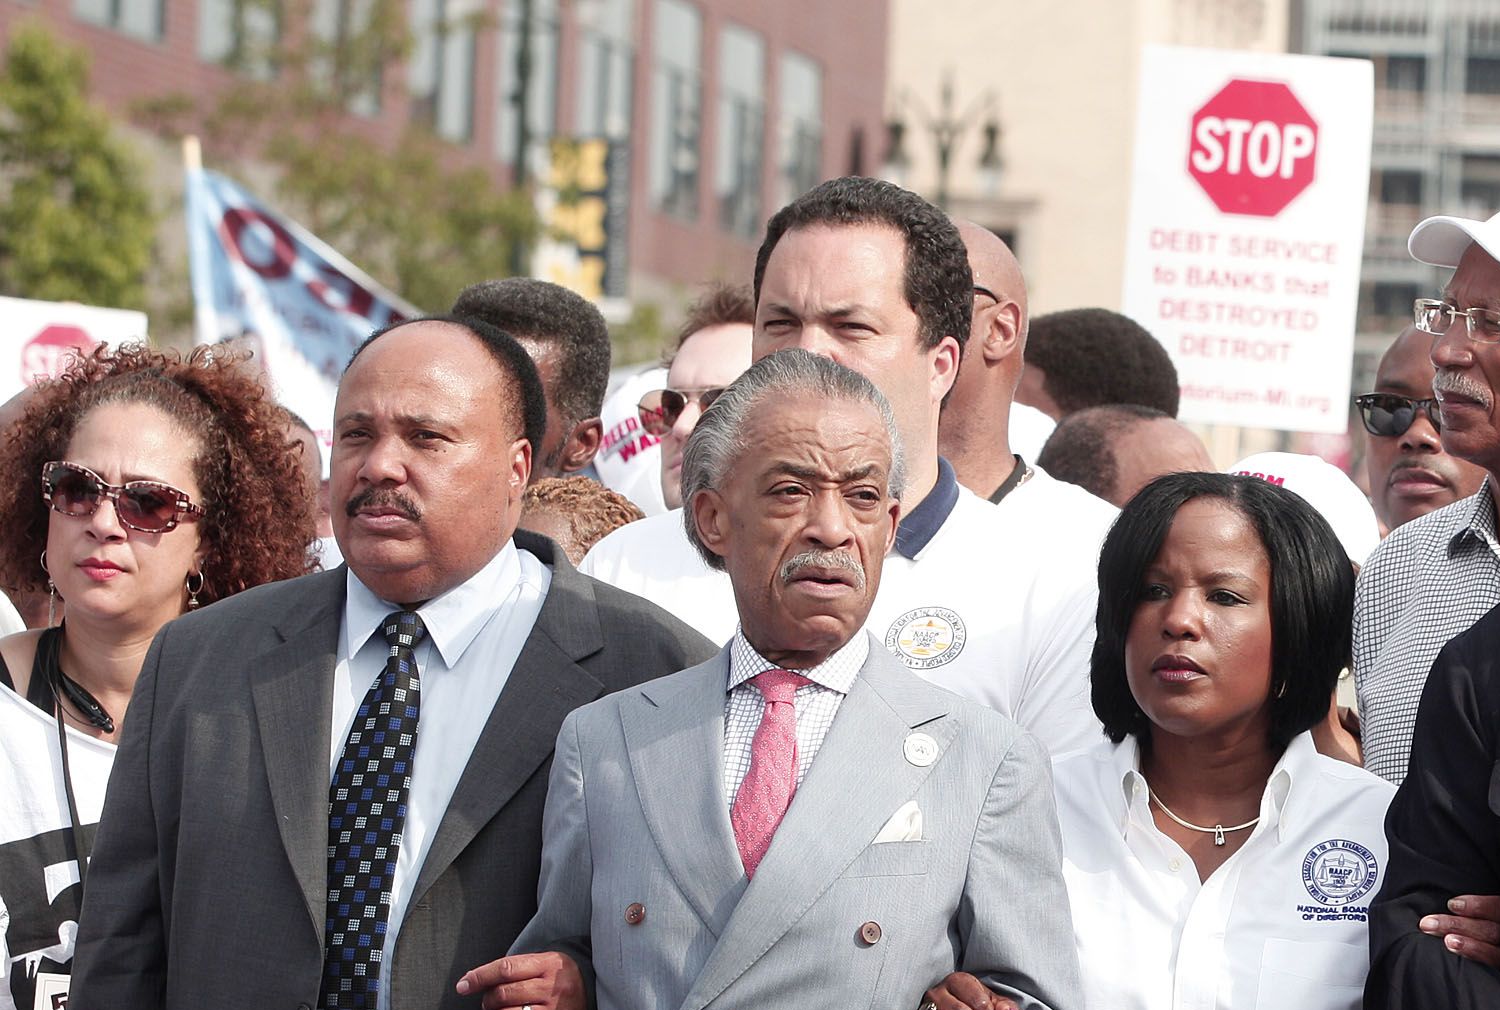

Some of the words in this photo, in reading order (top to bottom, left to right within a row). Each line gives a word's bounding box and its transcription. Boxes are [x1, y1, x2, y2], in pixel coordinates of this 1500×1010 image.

[1191, 115, 1315, 179] STOP
[1149, 229, 1220, 252] DEBT
[1228, 236, 1339, 265] SERVICE
[1153, 265, 1178, 285] to
[1185, 267, 1276, 293] BANKS
[1159, 298, 1318, 331] DESTROYED
[1179, 334, 1291, 362] DETROIT
[1328, 867, 1353, 876] NAACP
[1297, 905, 1338, 914] NATIONAL
[1342, 906, 1368, 914] BOAR
[1317, 914, 1367, 922] DIRECTORS
